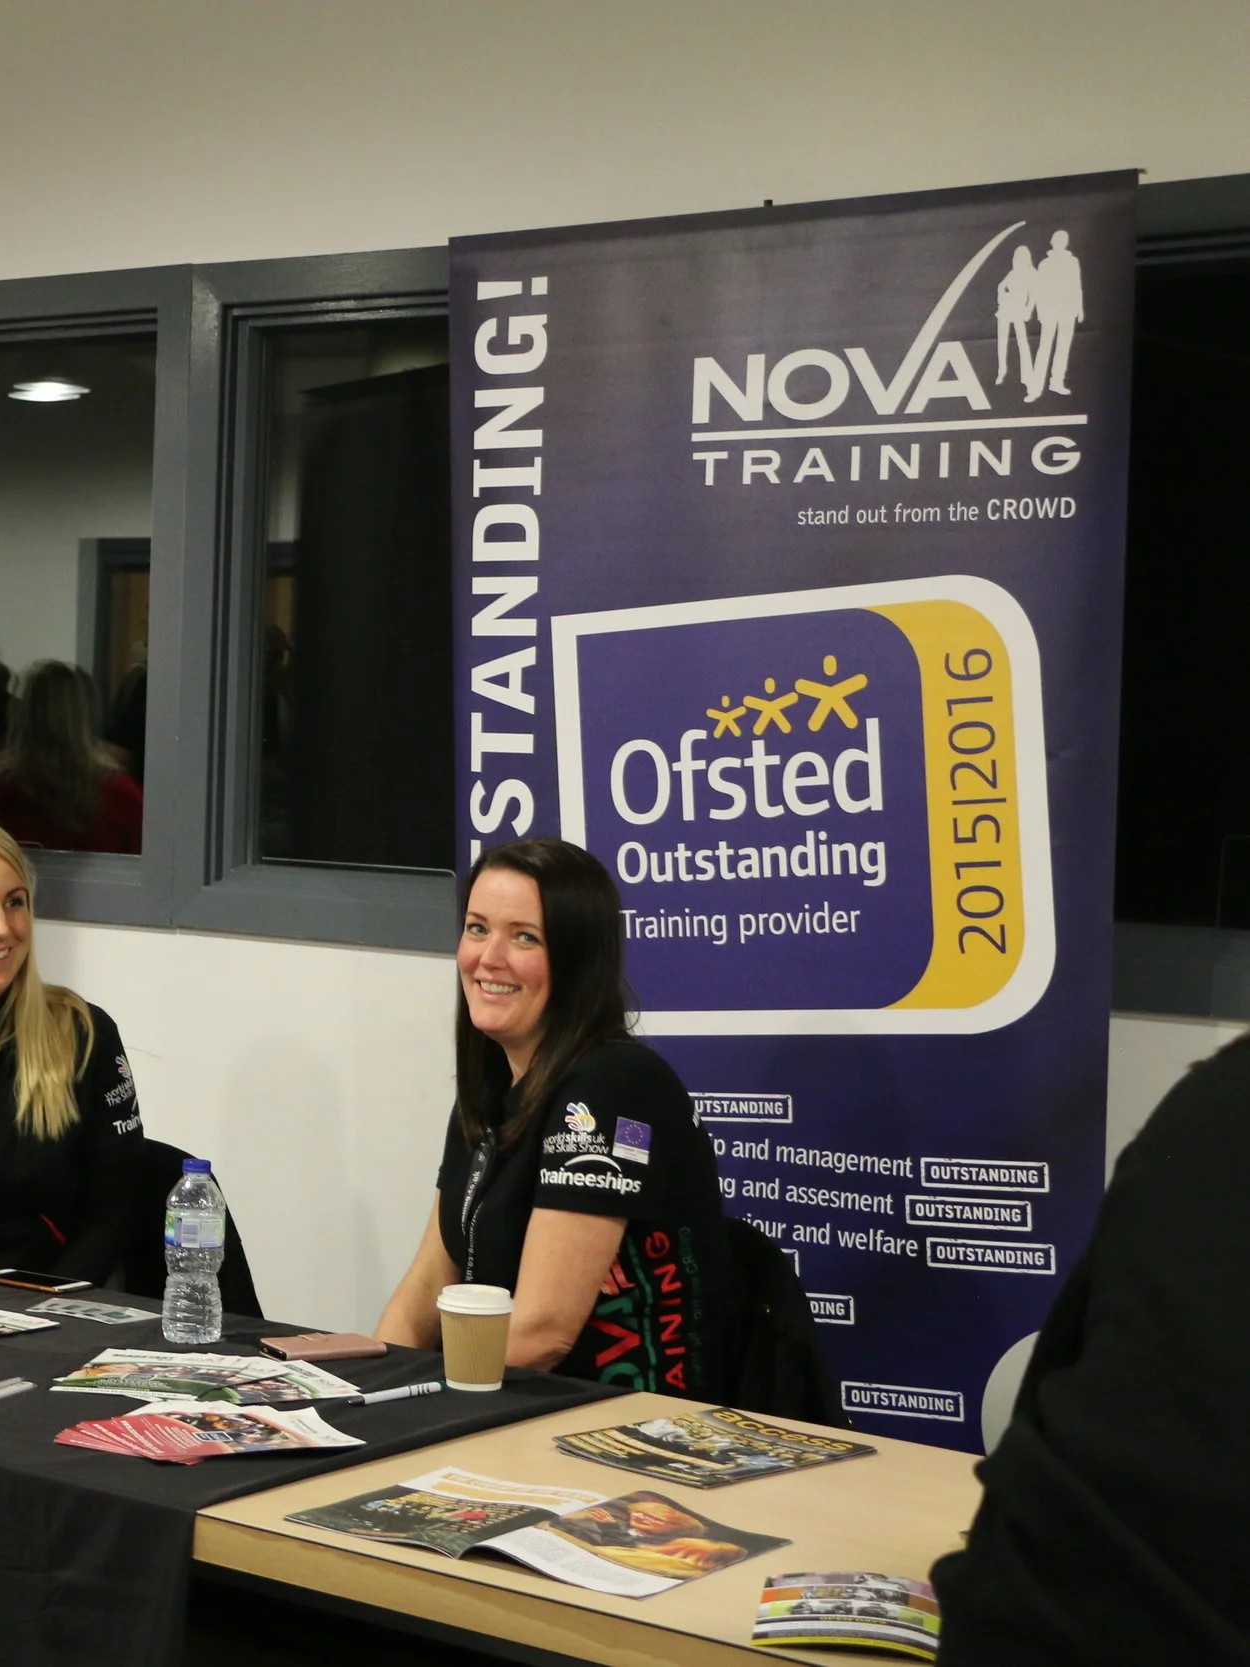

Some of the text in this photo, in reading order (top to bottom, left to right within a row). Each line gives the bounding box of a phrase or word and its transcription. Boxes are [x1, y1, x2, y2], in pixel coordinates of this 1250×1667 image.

[692, 341, 992, 424] NOVA
[692, 435, 1081, 486] TRAINING
[797, 496, 1076, 526] stand out from the CROWD
[470, 276, 549, 867] STANDING!
[610, 718, 883, 825] Ofsted
[616, 831, 887, 886] Outstanding
[619, 902, 861, 945] Training provider
[695, 1100, 784, 1116] UTSTANDING
[731, 1138, 769, 1161] and
[776, 1145, 914, 1179] management
[930, 1165, 1039, 1185] OUTSTANDING
[741, 1177, 780, 1200] and
[785, 1184, 894, 1215] assesment
[915, 1203, 1022, 1223] OUTSTANDING
[792, 1222, 830, 1245] and
[837, 1228, 918, 1257] welfare
[936, 1245, 1045, 1266] OUTSTANDING
[645, 1231, 686, 1389] AINING
[851, 1390, 955, 1412] OUTSTANDING
[712, 1411, 854, 1452] access
